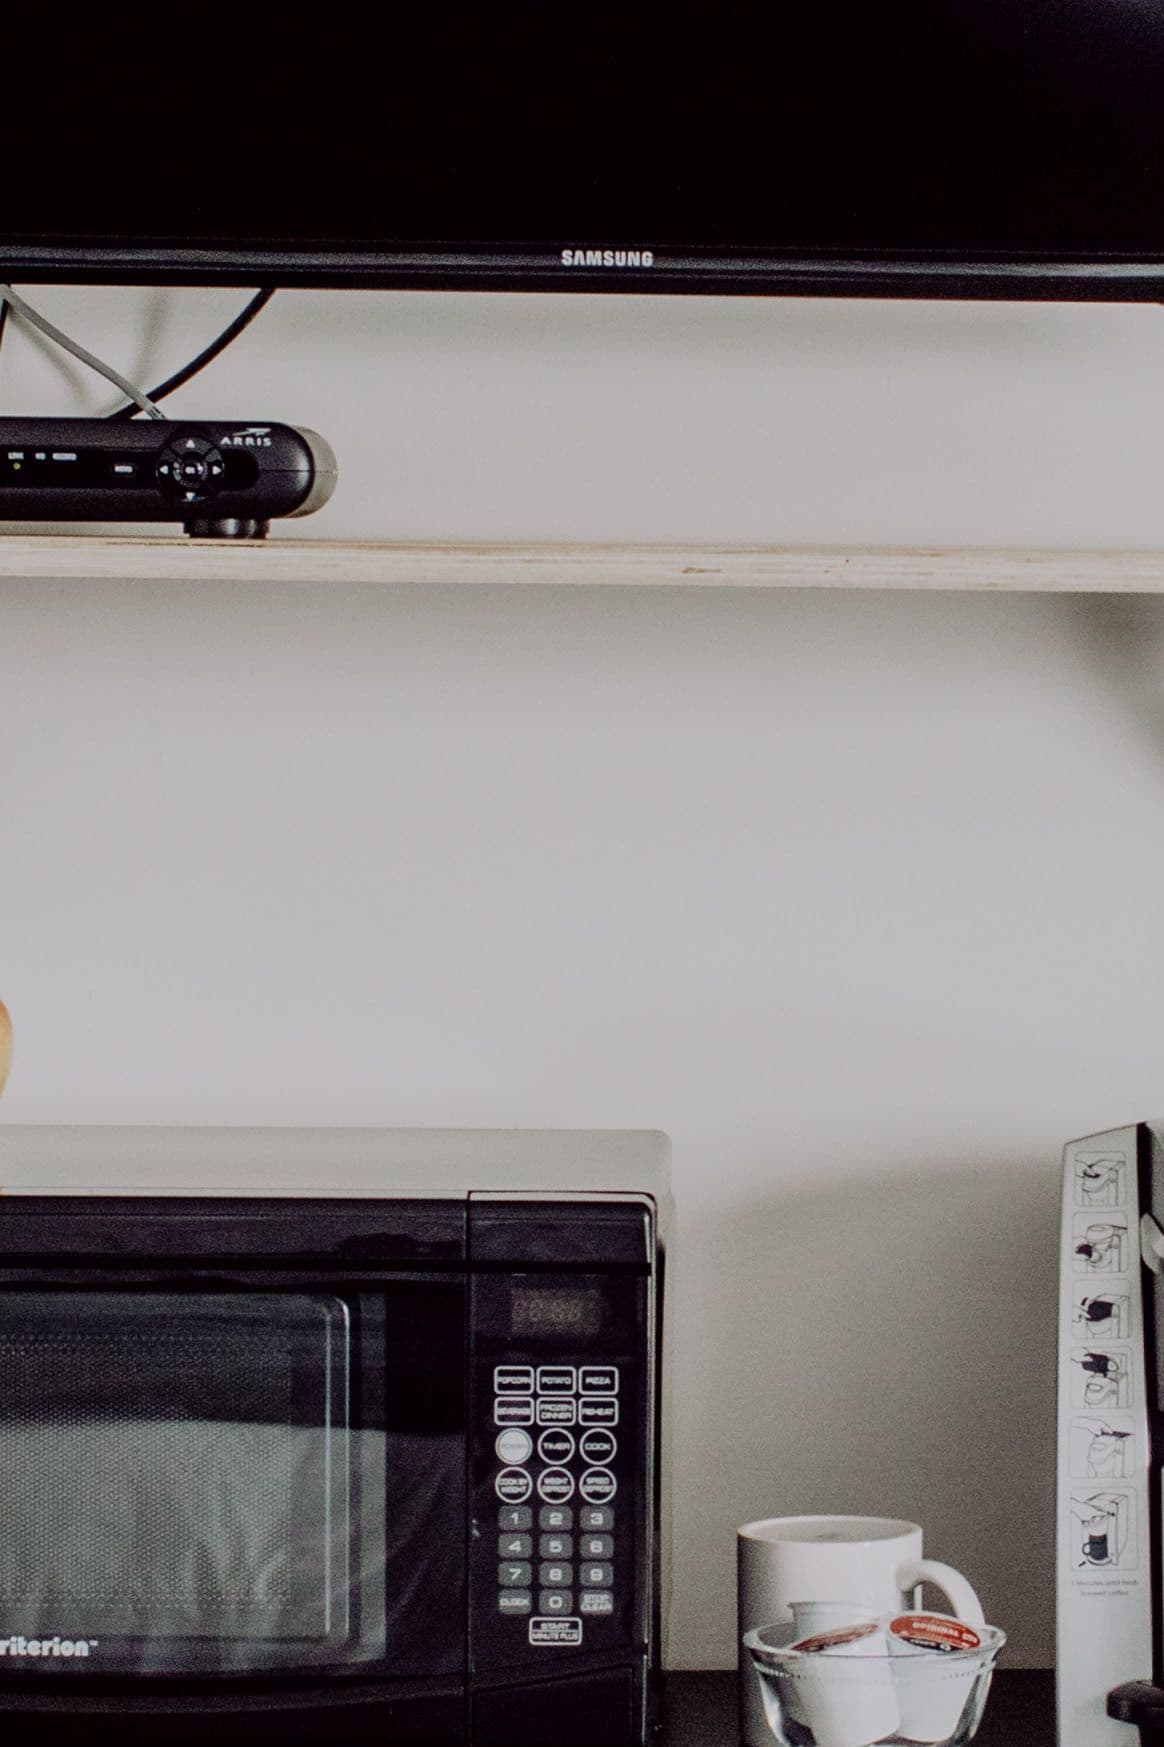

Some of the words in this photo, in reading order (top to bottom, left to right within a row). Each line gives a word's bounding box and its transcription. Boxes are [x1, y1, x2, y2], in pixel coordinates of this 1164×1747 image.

[561, 249, 654, 267] SAMSUNG
[220, 436, 272, 447] ARRIS
[541, 1376, 572, 1385] POTATO
[585, 1376, 611, 1385] PIZZA
[542, 1442, 571, 1451] TIMER
[584, 1442, 611, 1451] COOK
[510, 1512, 520, 1525] 1
[549, 1512, 563, 1525] 2
[590, 1512, 604, 1525] 3
[508, 1540, 522, 1552] 4
[549, 1540, 563, 1553] 5
[590, 1540, 603, 1553] 6
[509, 1568, 522, 1580] 7
[549, 1568, 562, 1581] 8
[590, 1568, 603, 1581] 9
[548, 1596, 563, 1609] 0
[541, 1623, 570, 1631] START
[0, 1636, 90, 1656] riterion
